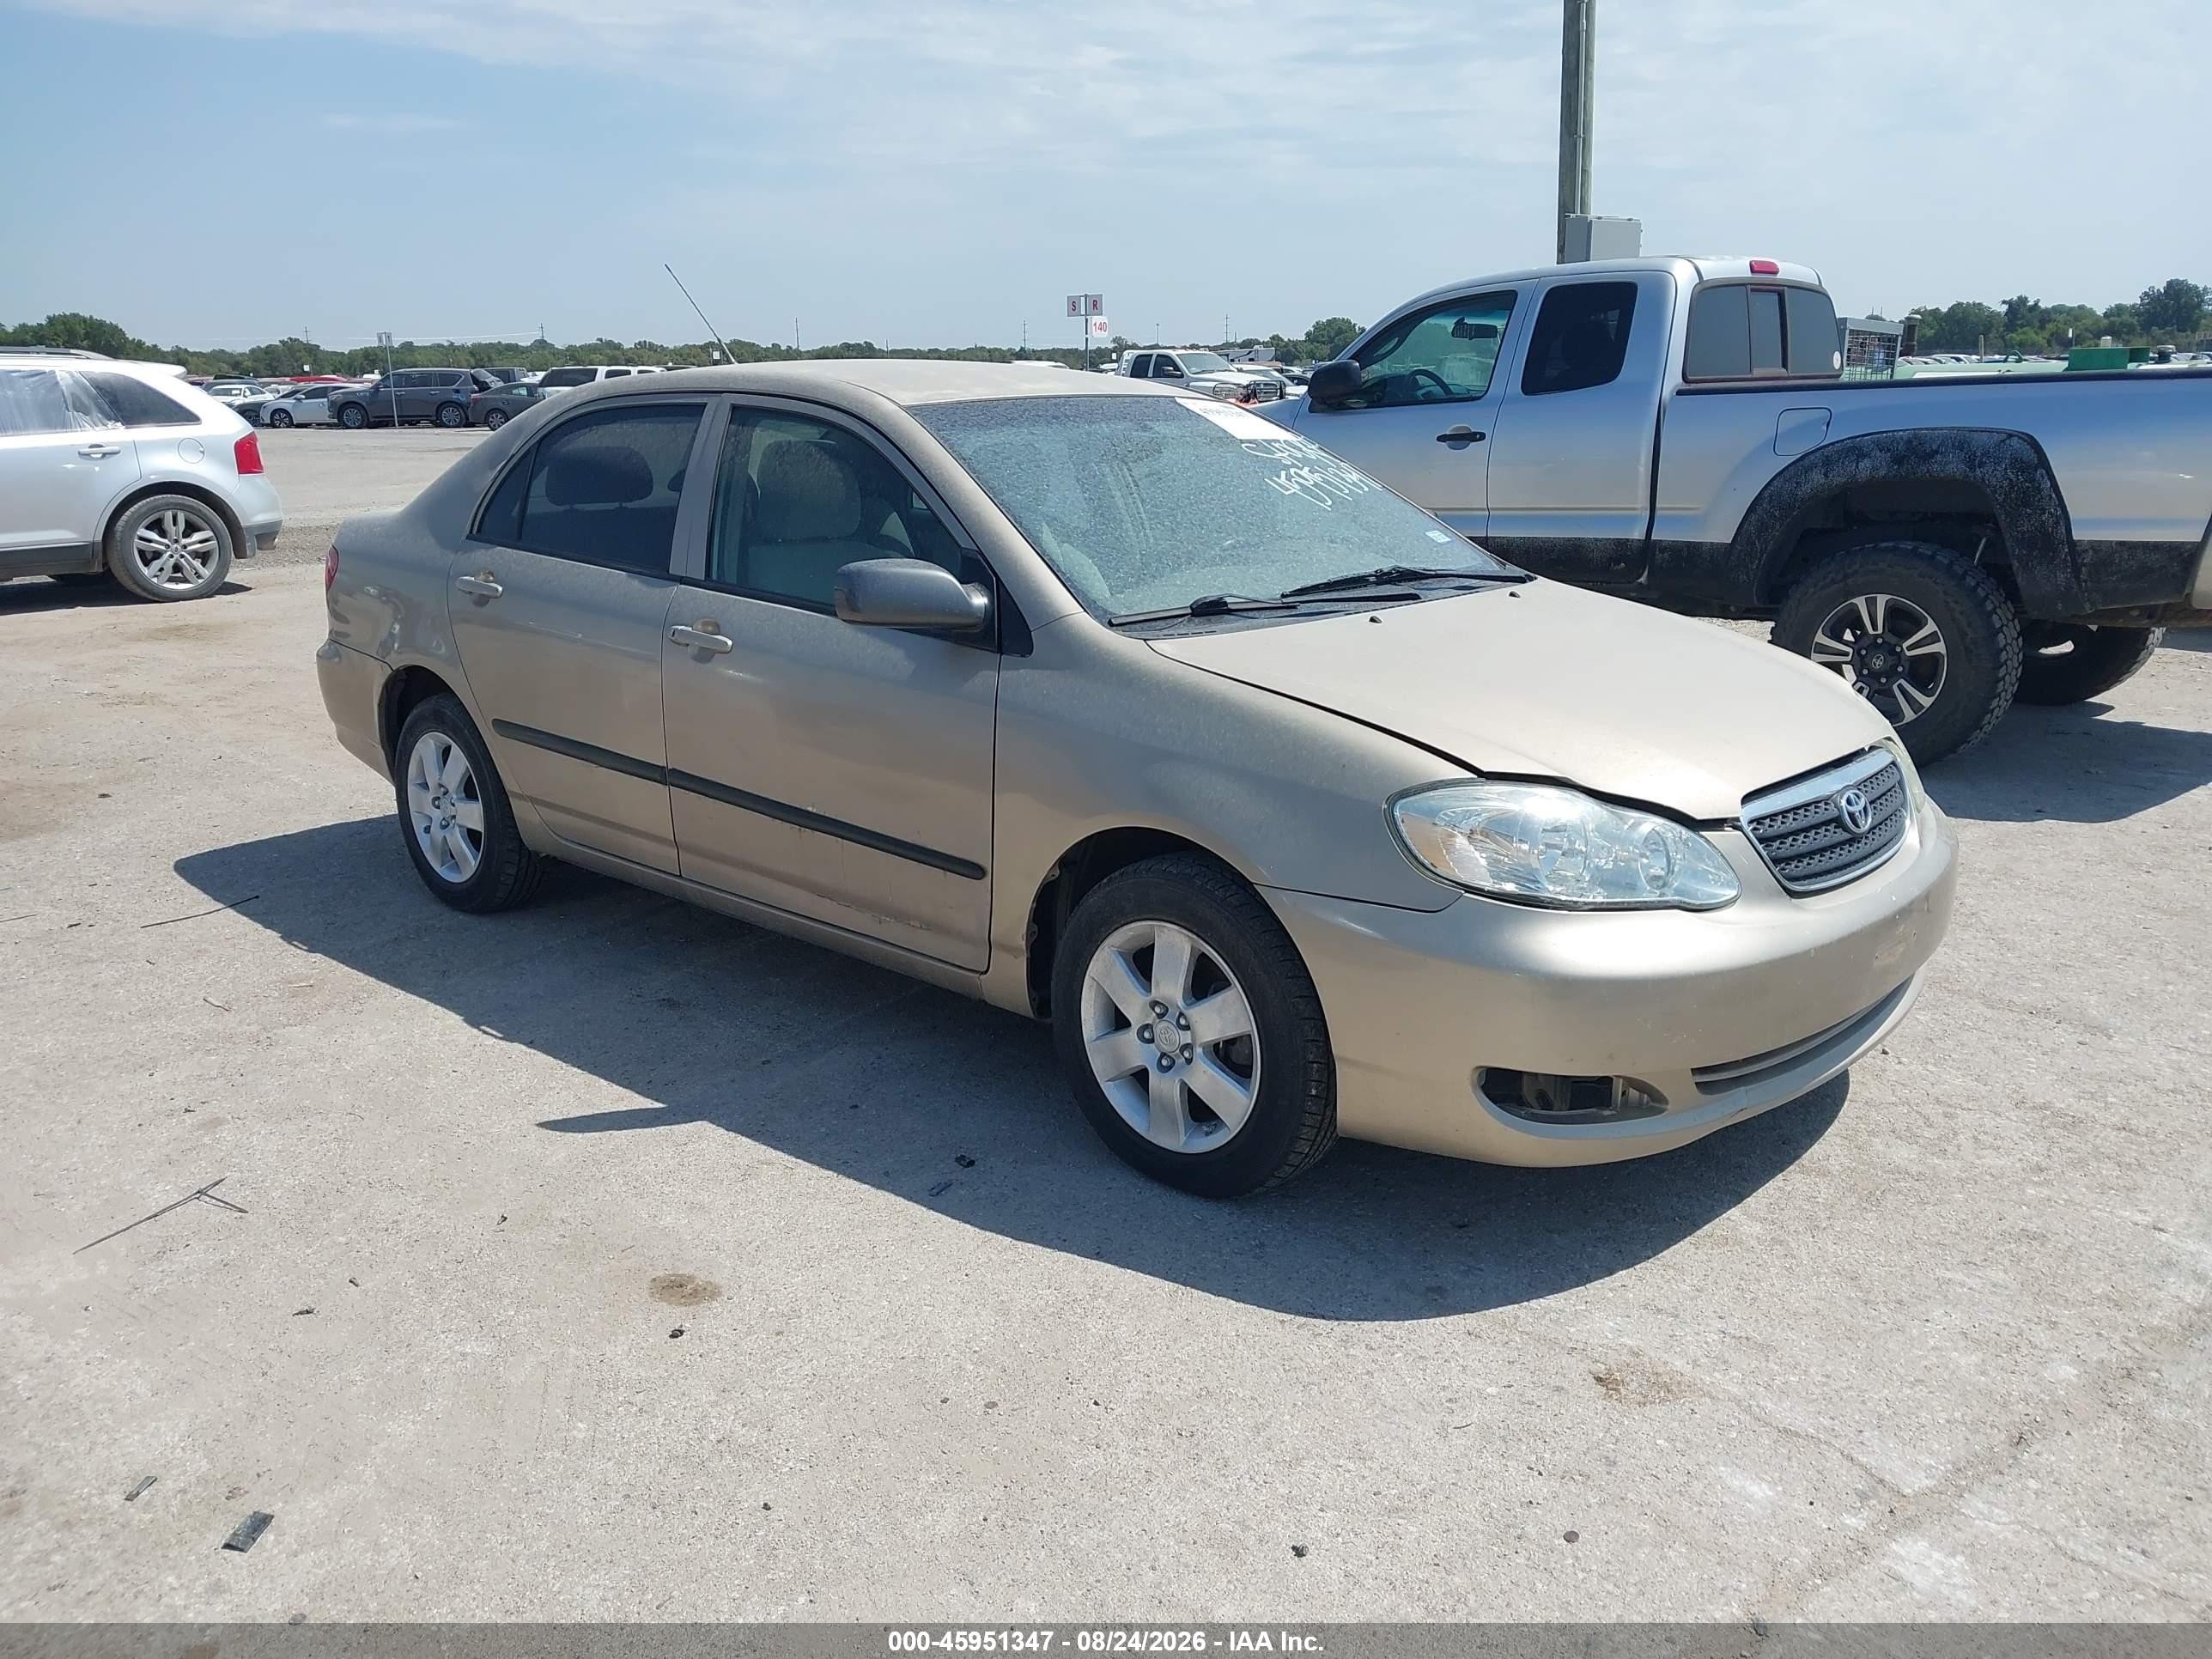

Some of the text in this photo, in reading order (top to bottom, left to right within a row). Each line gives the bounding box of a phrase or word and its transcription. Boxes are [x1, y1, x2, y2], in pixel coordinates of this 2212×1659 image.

[1071, 301, 1077, 312] S
[1092, 300, 1099, 311] R
[1093, 321, 1108, 332] 140
